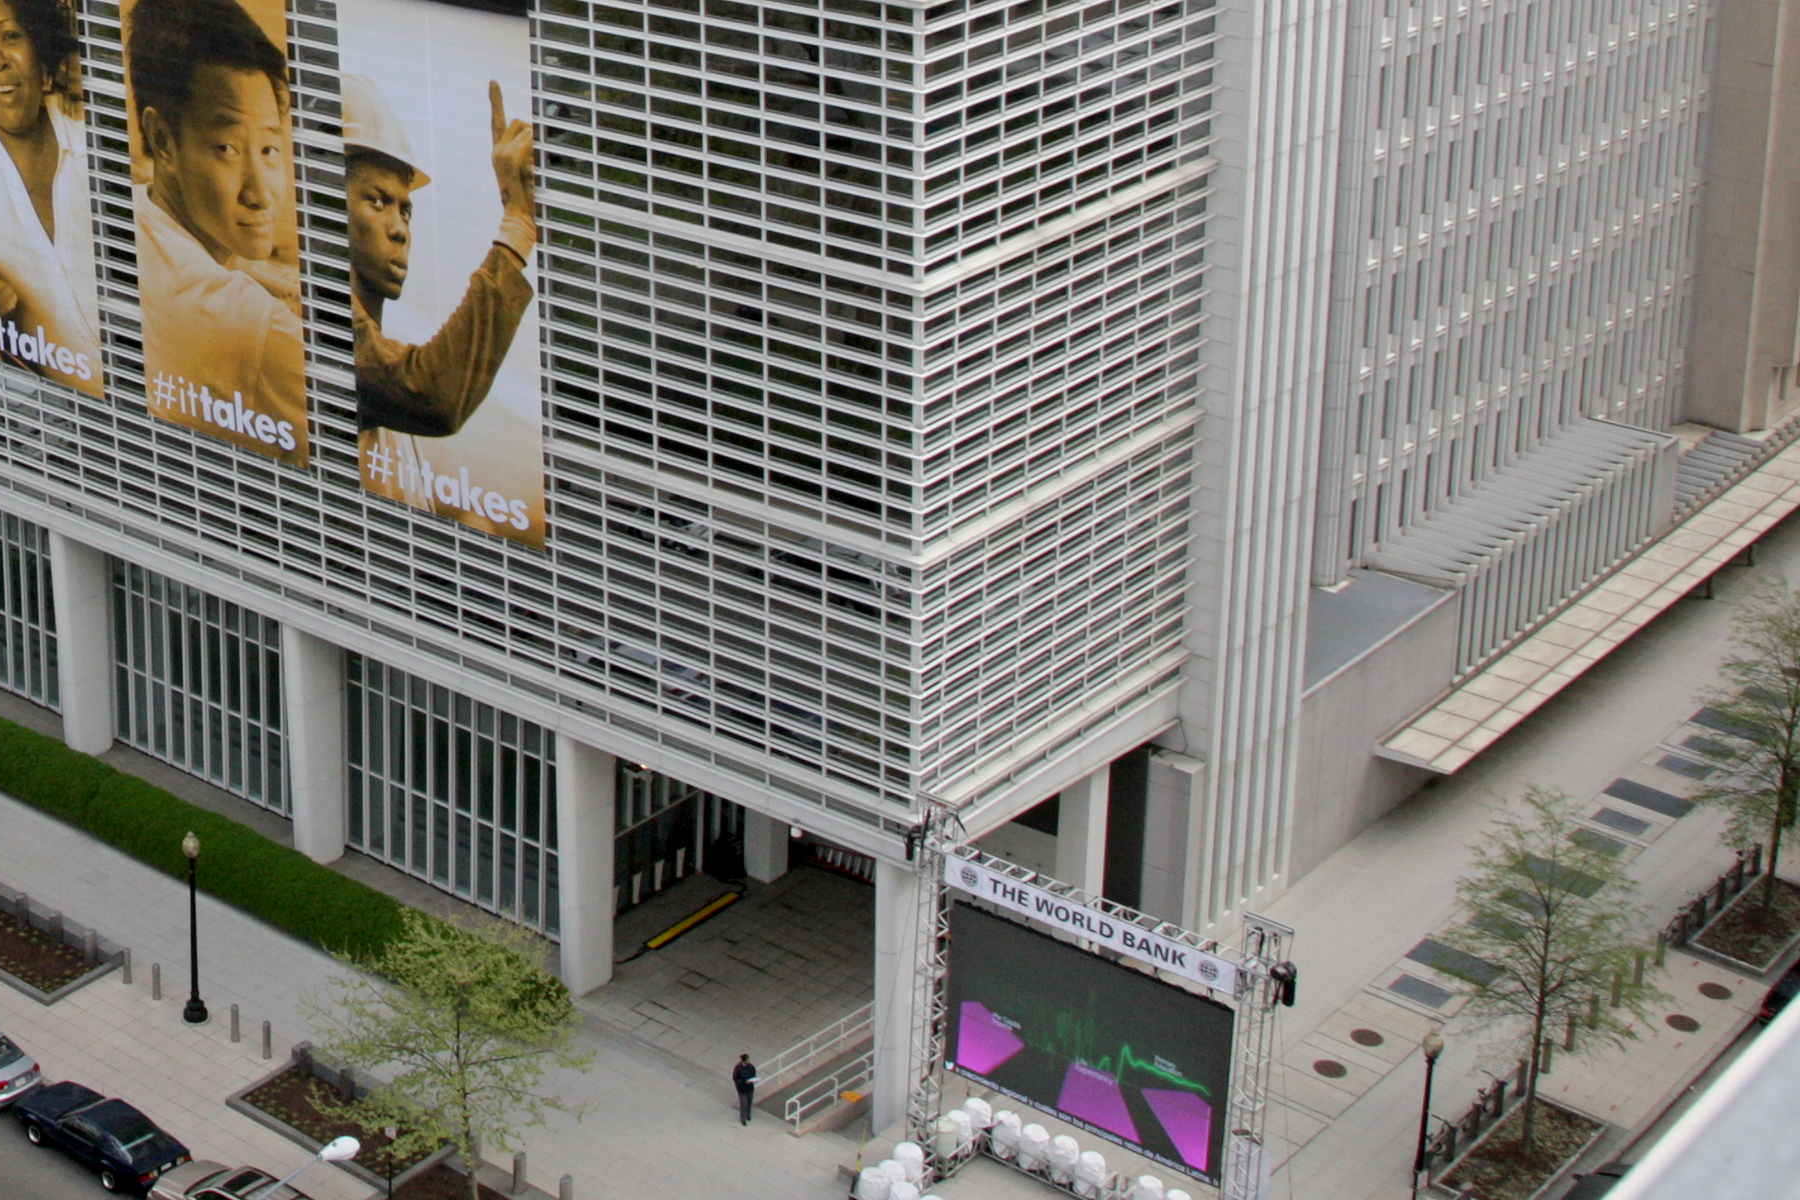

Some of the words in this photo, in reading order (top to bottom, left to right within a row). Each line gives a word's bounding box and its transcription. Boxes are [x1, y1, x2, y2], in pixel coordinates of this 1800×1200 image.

[152, 370, 296, 452] #ittakes
[365, 442, 531, 532] #ittakes
[989, 877, 1029, 908] THE
[1034, 895, 1114, 940] WORLD
[1121, 931, 1187, 969] BANK
